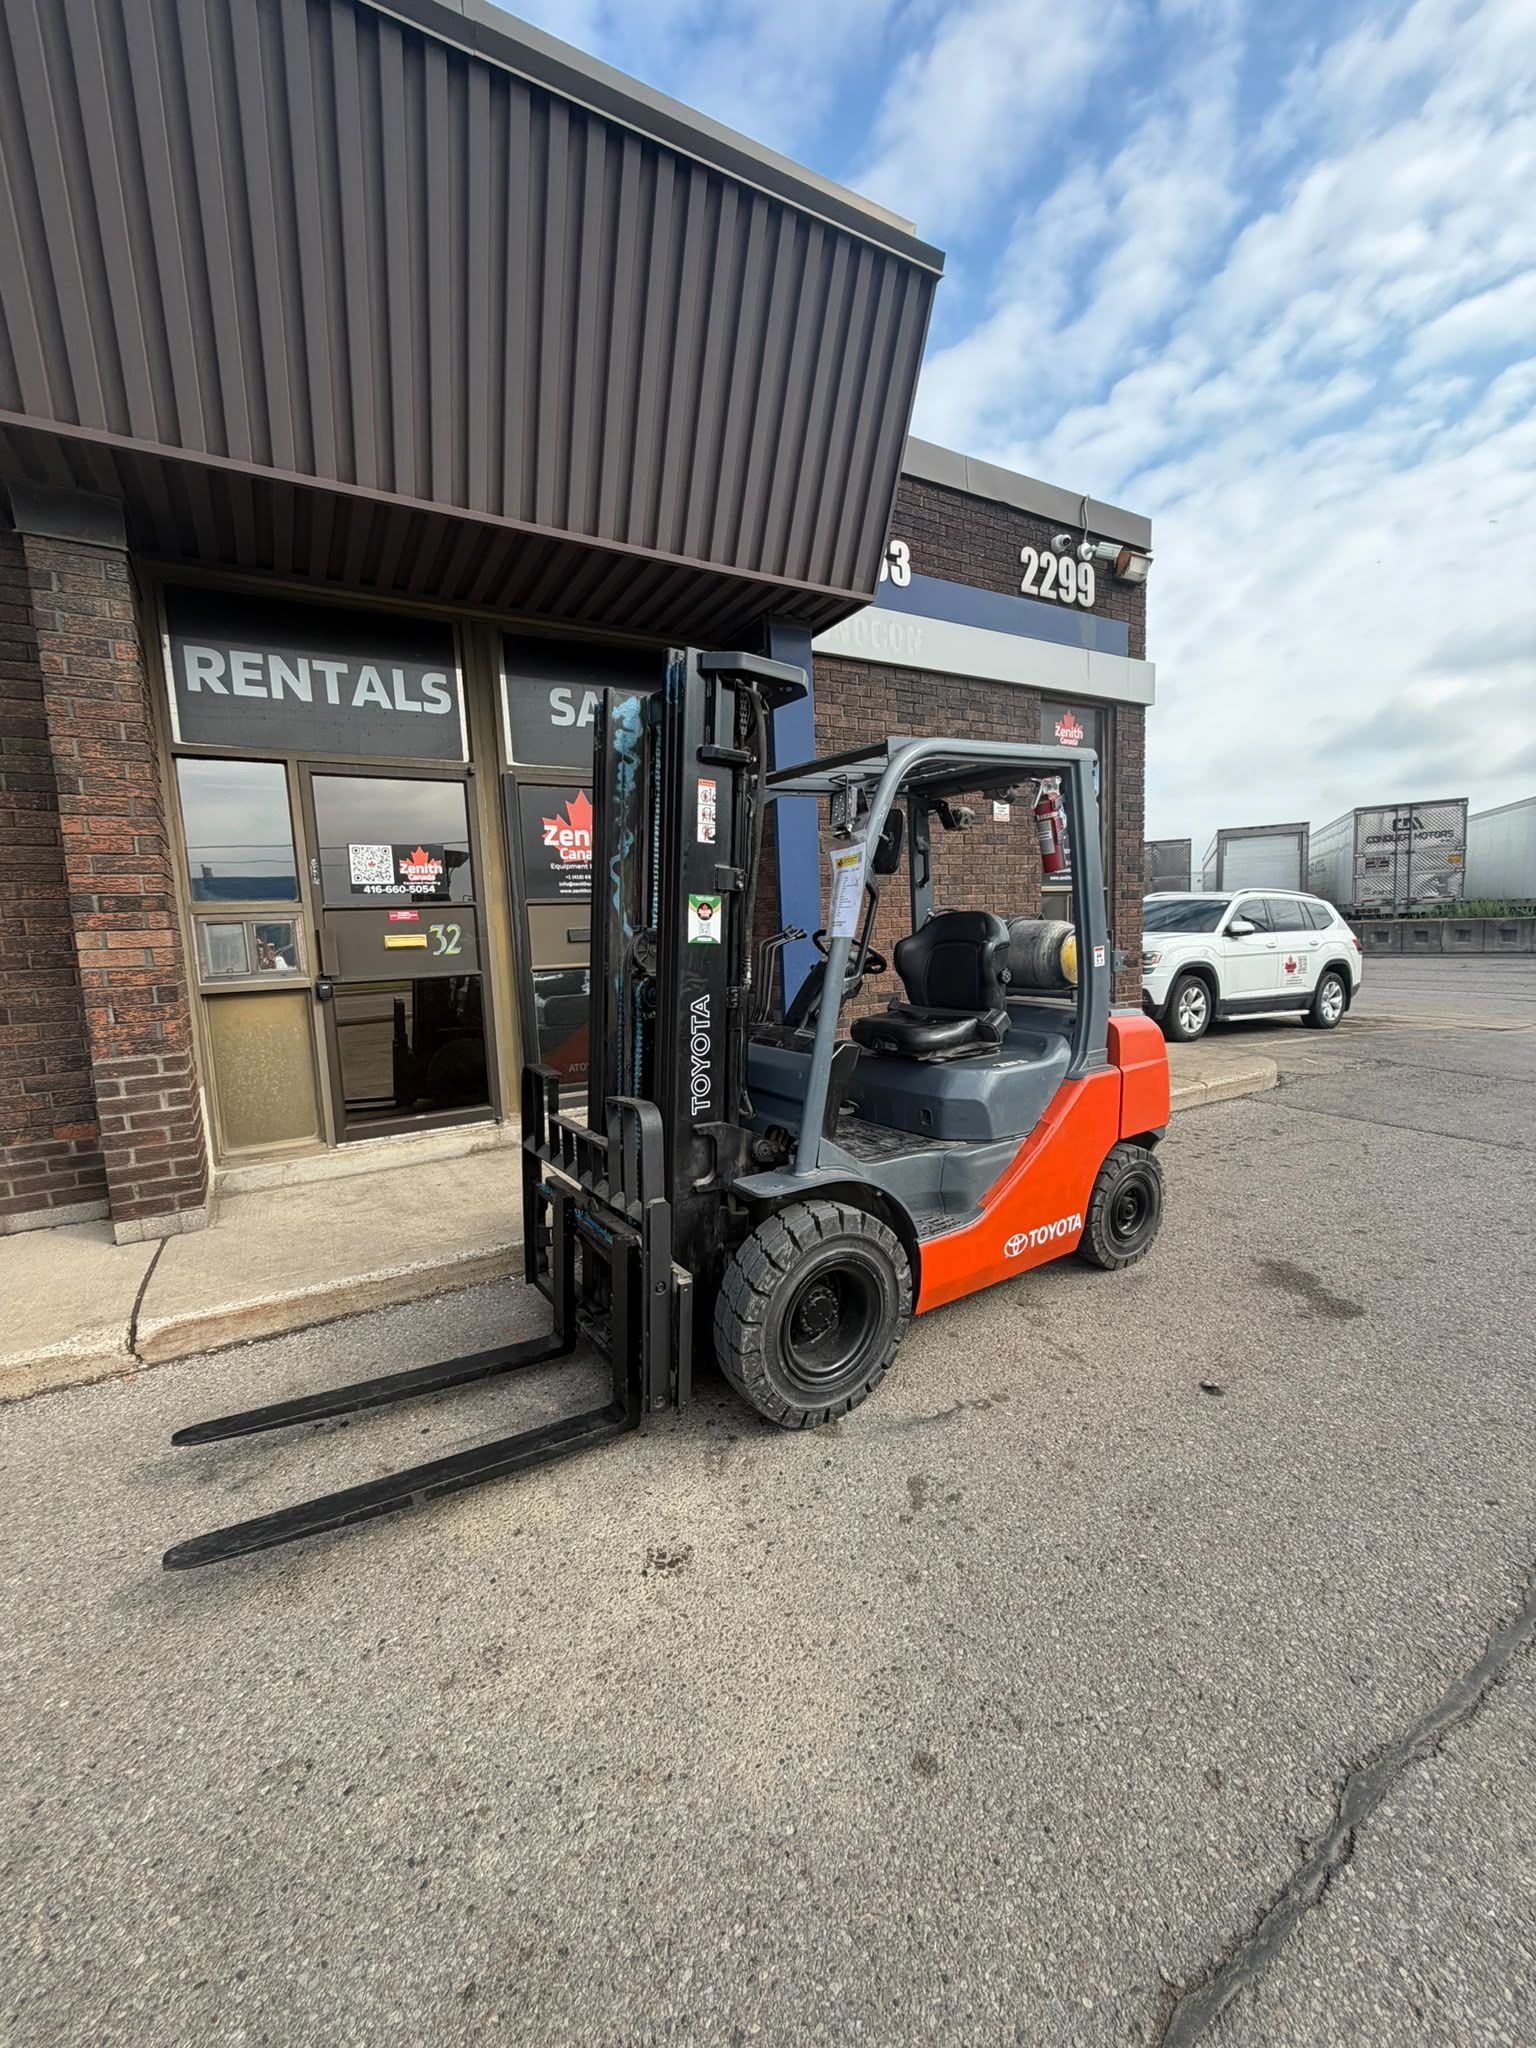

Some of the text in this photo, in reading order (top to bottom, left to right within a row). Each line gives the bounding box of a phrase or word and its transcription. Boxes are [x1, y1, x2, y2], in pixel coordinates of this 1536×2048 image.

[880, 540, 911, 587] 3
[1021, 547, 1095, 607] 2299
[183, 645, 451, 714] RENTALS
[1054, 725, 1083, 739] Zenith
[1413, 830, 1455, 841] MOTORS
[399, 863, 443, 875] Zenith
[363, 885, 436, 894] 416-660-5054
[429, 924, 461, 955] 32
[691, 994, 711, 1115] TOYOTA
[1028, 1213, 1082, 1248] TOYOTA
